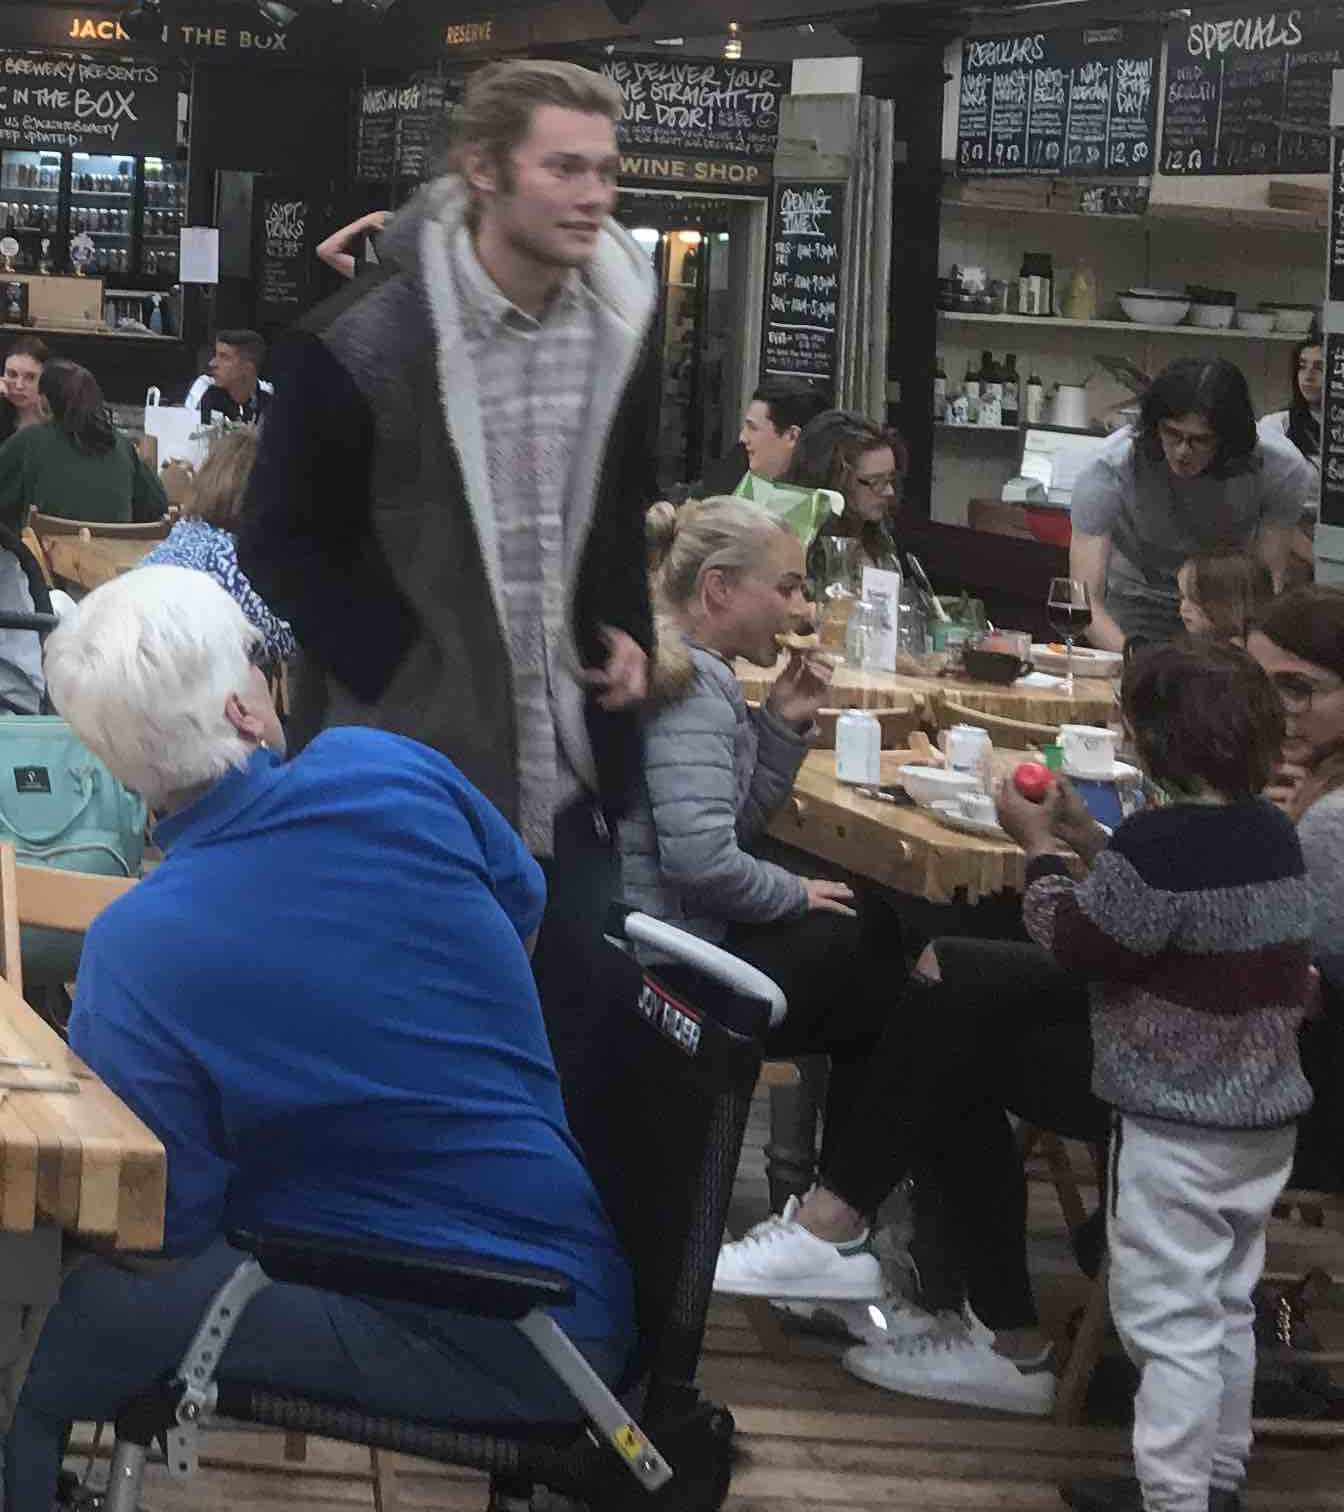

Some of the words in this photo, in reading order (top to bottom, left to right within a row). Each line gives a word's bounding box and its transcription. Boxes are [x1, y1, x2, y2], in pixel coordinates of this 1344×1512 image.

[181, 26, 227, 46] THE
[239, 31, 287, 51] BOX
[1187, 9, 1302, 59] SPECIALS
[967, 34, 1045, 70] REGULARS
[5, 57, 75, 84] BREWERY
[79, 64, 158, 83] PRESENTS
[633, 62, 721, 85] DELIVER
[724, 67, 782, 88] YOUR
[13, 88, 29, 105] IN
[32, 89, 72, 108] THE
[74, 90, 137, 121] BOX
[650, 82, 750, 108] STRAIGHT
[746, 92, 775, 112] TO
[4, 116, 19, 128] US
[656, 104, 713, 130] DOOR!
[619, 156, 688, 177] WINE
[694, 162, 758, 182] SHOP
[271, 201, 303, 223] SOFT
[662, 1001, 701, 1054] RIDER
